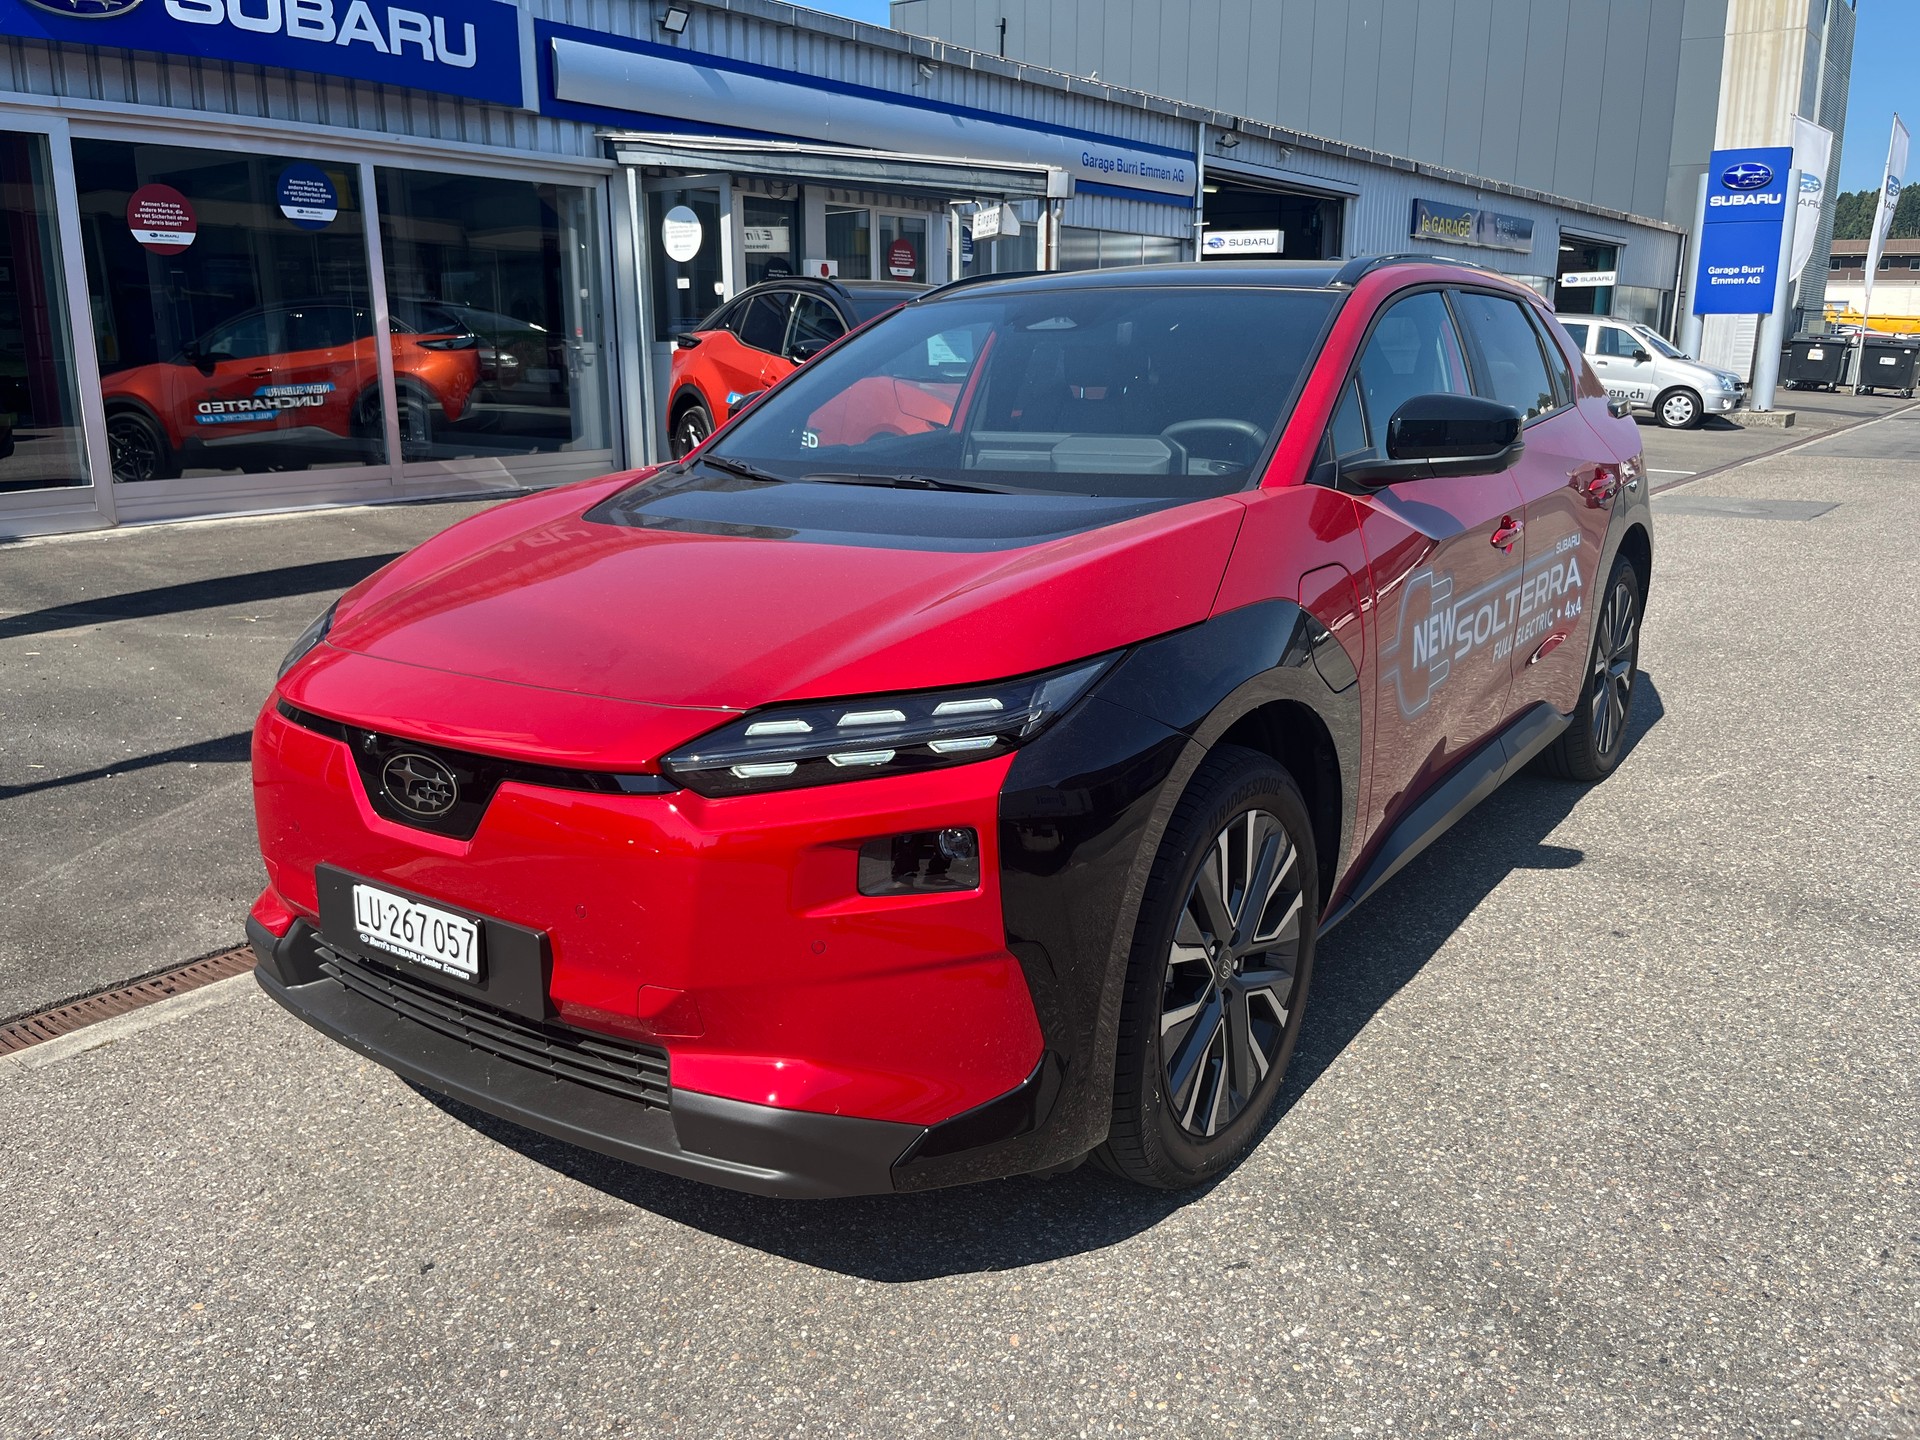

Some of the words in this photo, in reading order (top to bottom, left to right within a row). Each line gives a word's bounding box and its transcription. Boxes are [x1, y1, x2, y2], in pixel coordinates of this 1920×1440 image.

[1081, 152, 1115, 173] Garage
[1117, 158, 1138, 175] Burri
[1140, 162, 1171, 180] Emmen
[1172, 168, 1185, 182] AG
[1709, 193, 1782, 207] SUBARU
[1797, 198, 1820, 209] ARU
[1421, 214, 1429, 232] le
[1431, 216, 1471, 238] GARAGE
[1228, 238, 1275, 246] SUBARU
[1707, 266, 1740, 275] Garage
[1741, 265, 1765, 274] Burri
[1711, 276, 1745, 285] Emmen
[1746, 276, 1761, 284] AG
[1605, 388, 1644, 399] en.ch
[1555, 533, 1581, 554] SUBARU
[1413, 604, 1456, 669] NEW
[1455, 557, 1582, 660] SOLTERRA
[1492, 637, 1513, 663] FULL
[1514, 608, 1553, 649] ELECTRIC
[1564, 596, 1582, 618] 4x4
[390, 945, 421, 962] SUBARU
[420, 954, 443, 970] Center
[443, 963, 470, 980] Emmen
